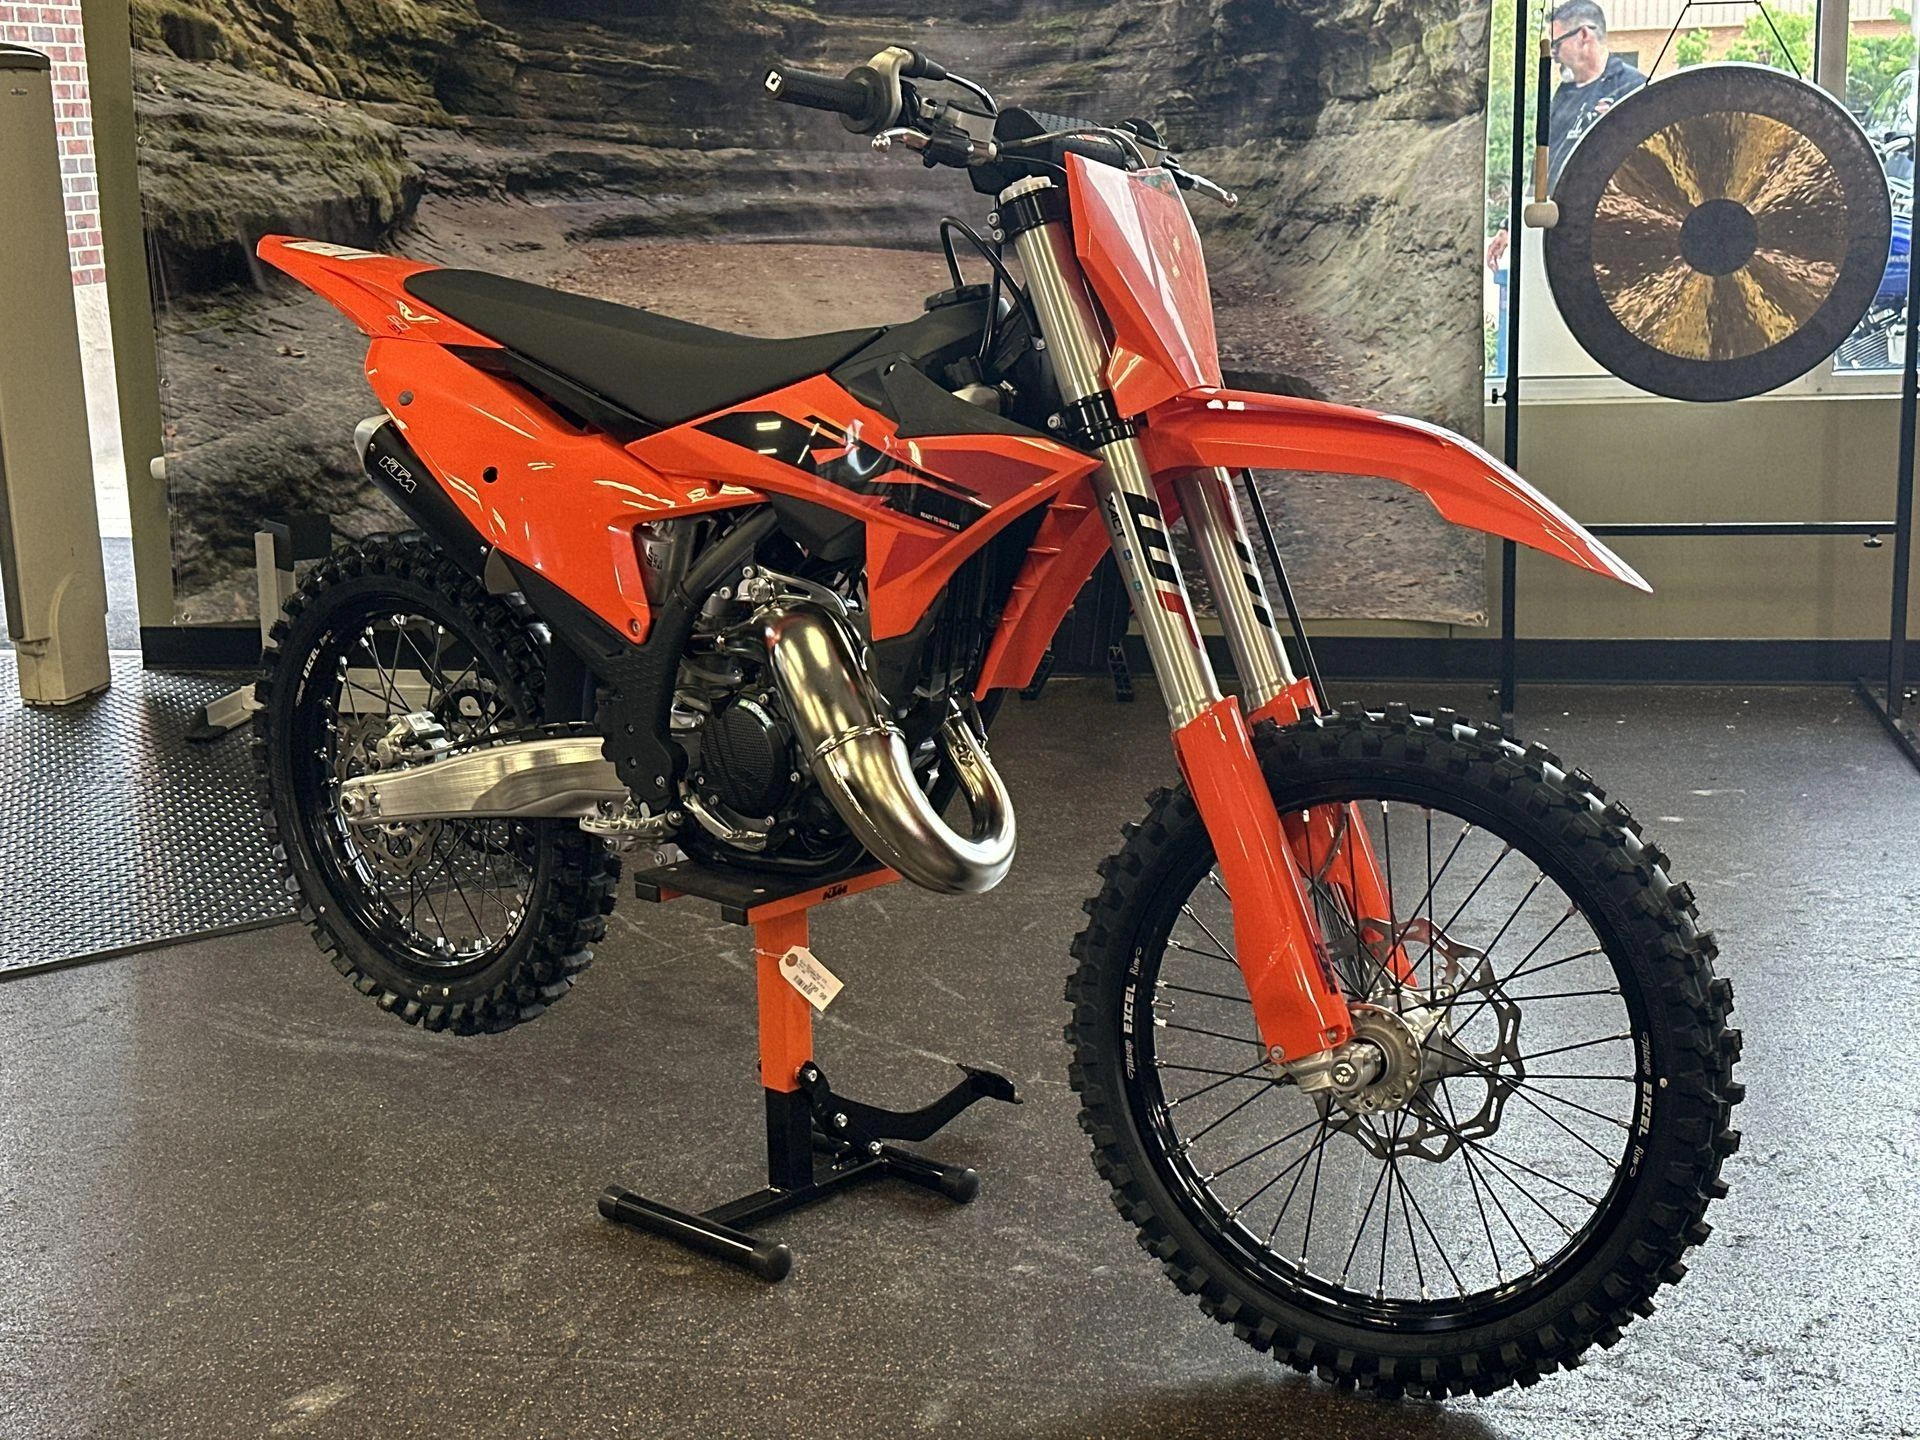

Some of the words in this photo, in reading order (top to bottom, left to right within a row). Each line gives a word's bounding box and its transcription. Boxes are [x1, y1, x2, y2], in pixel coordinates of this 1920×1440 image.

[378, 455, 417, 493] KTM
[1105, 497, 1126, 538] XACT
[1123, 983, 1136, 1035] EXCEL
[1638, 1081, 1653, 1137] EXCEL
